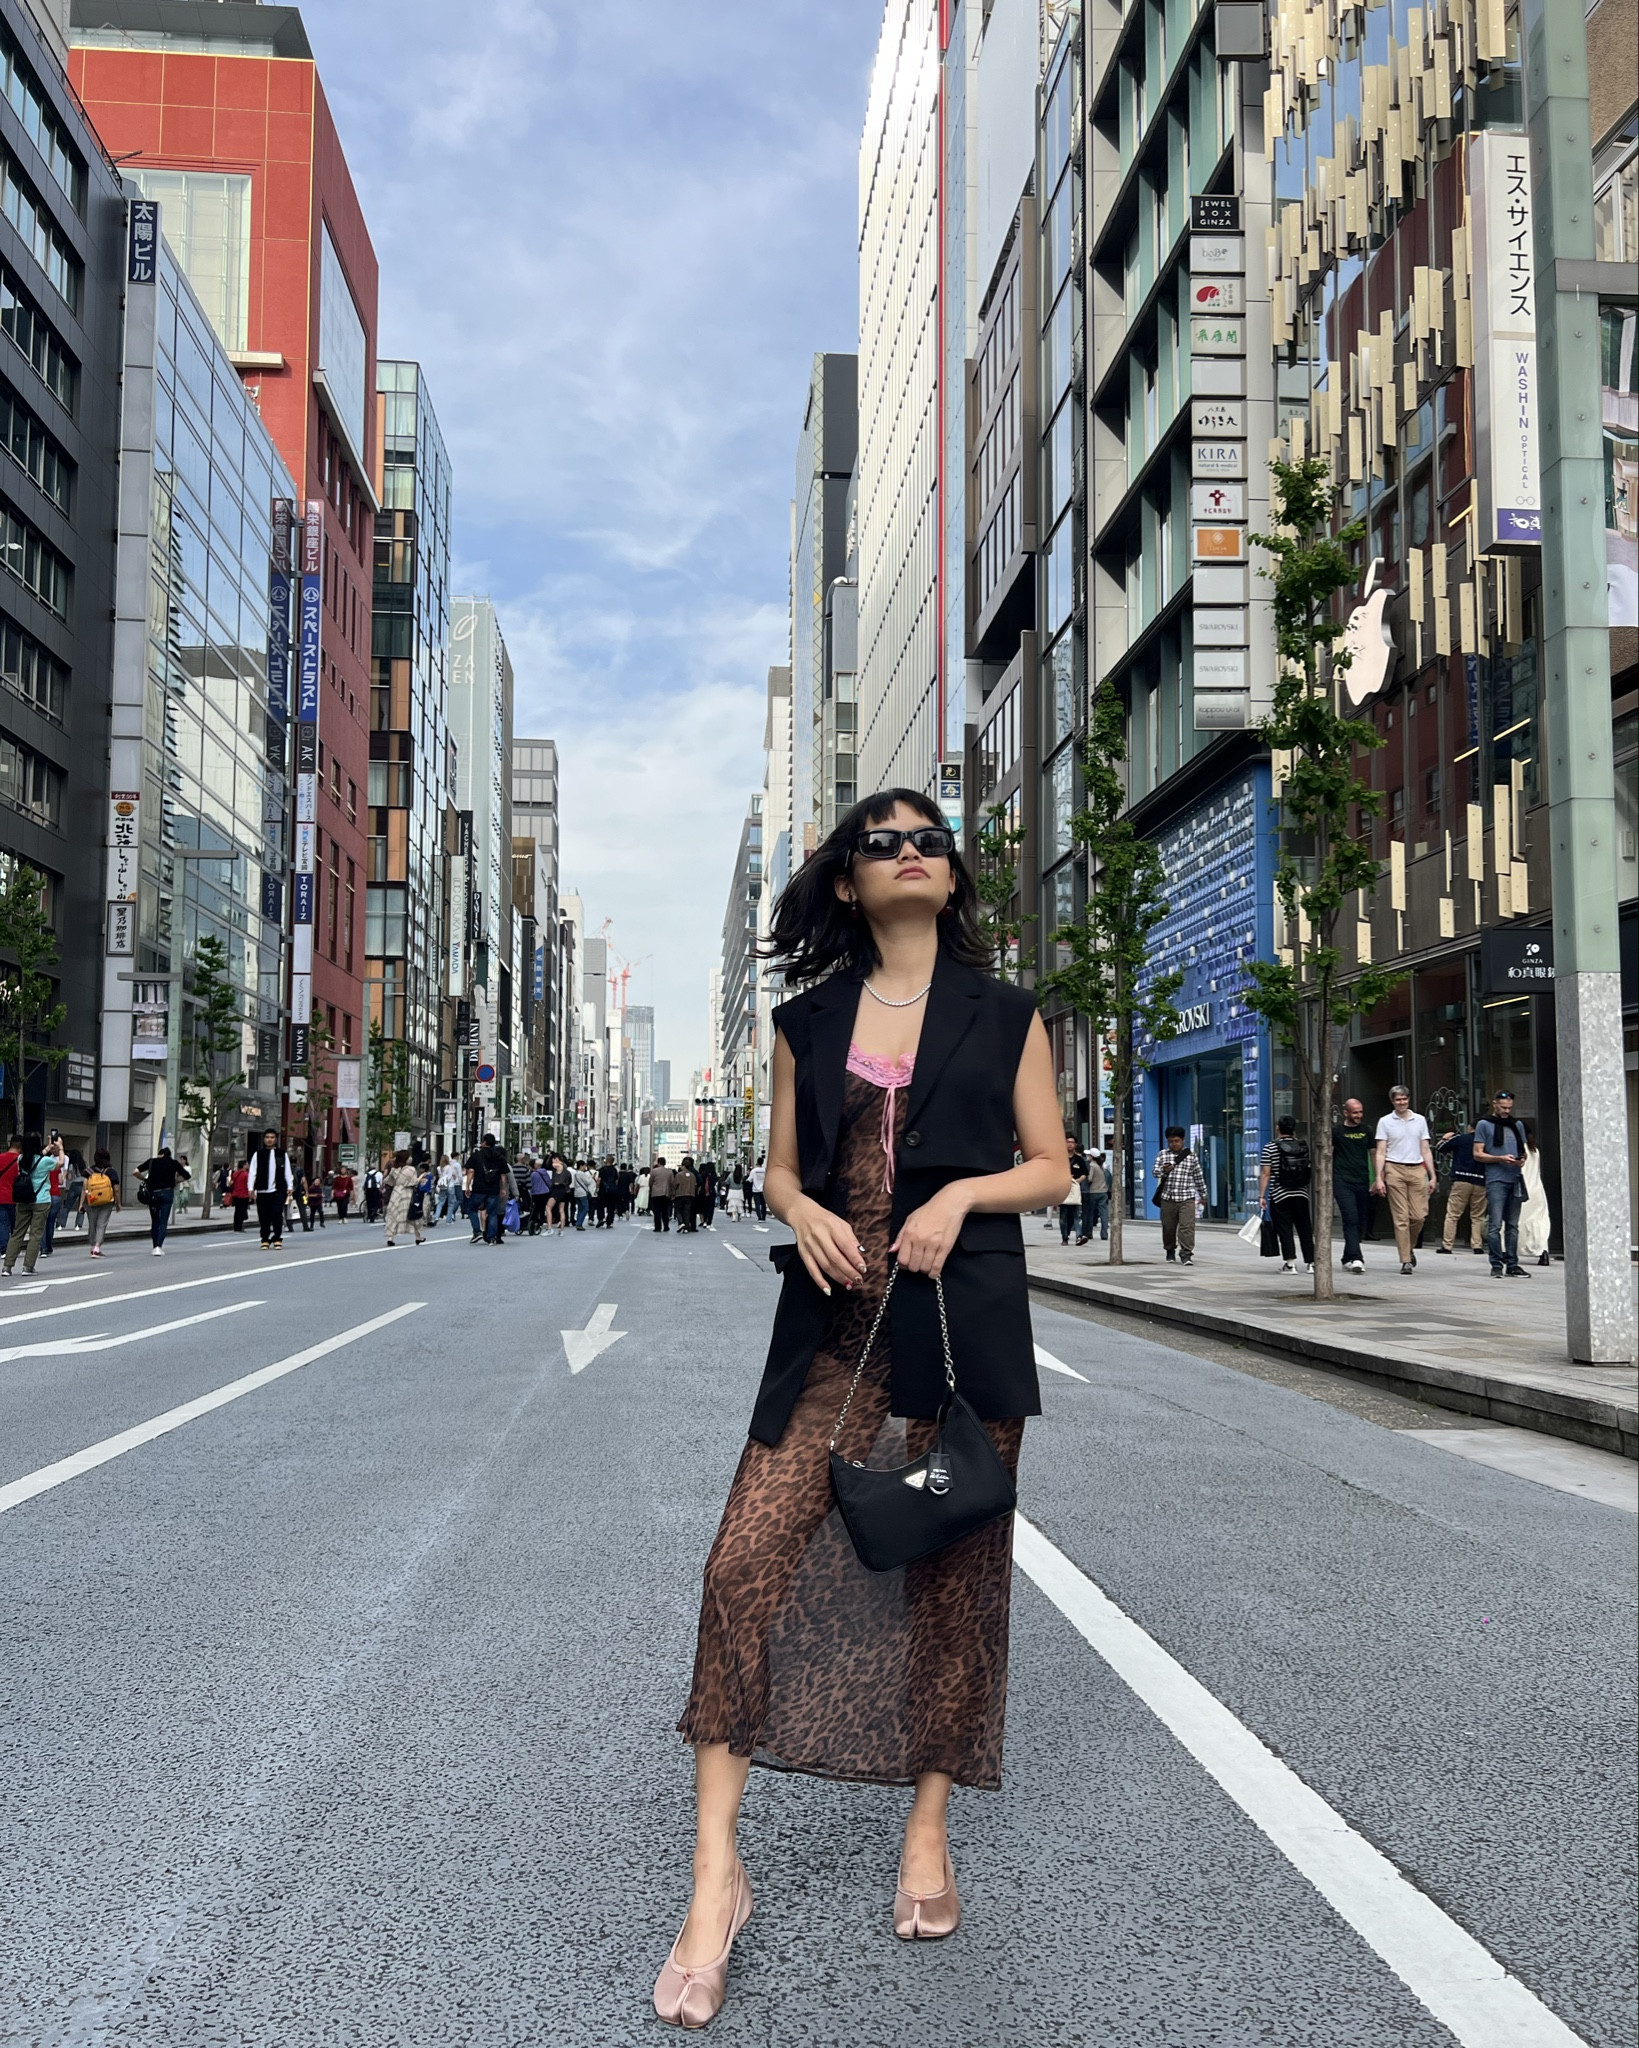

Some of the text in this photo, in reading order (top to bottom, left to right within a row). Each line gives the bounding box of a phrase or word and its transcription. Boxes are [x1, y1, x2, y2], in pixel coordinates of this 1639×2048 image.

[1200, 200, 1231, 208] JEWEL
[132, 202, 154, 281] 太陽ビル
[1506, 155, 1531, 316] エス・サイエンス
[1516, 353, 1529, 489] WASHIN OPTICAL
[1198, 448, 1238, 460] KIRA
[306, 501, 320, 572] 陽栄銀座ビル
[302, 606, 317, 710] スペーストラスト
[301, 745, 313, 761] AK
[300, 877, 308, 919] TORAIZ
[1161, 1002, 1210, 1035] ROVSKI
